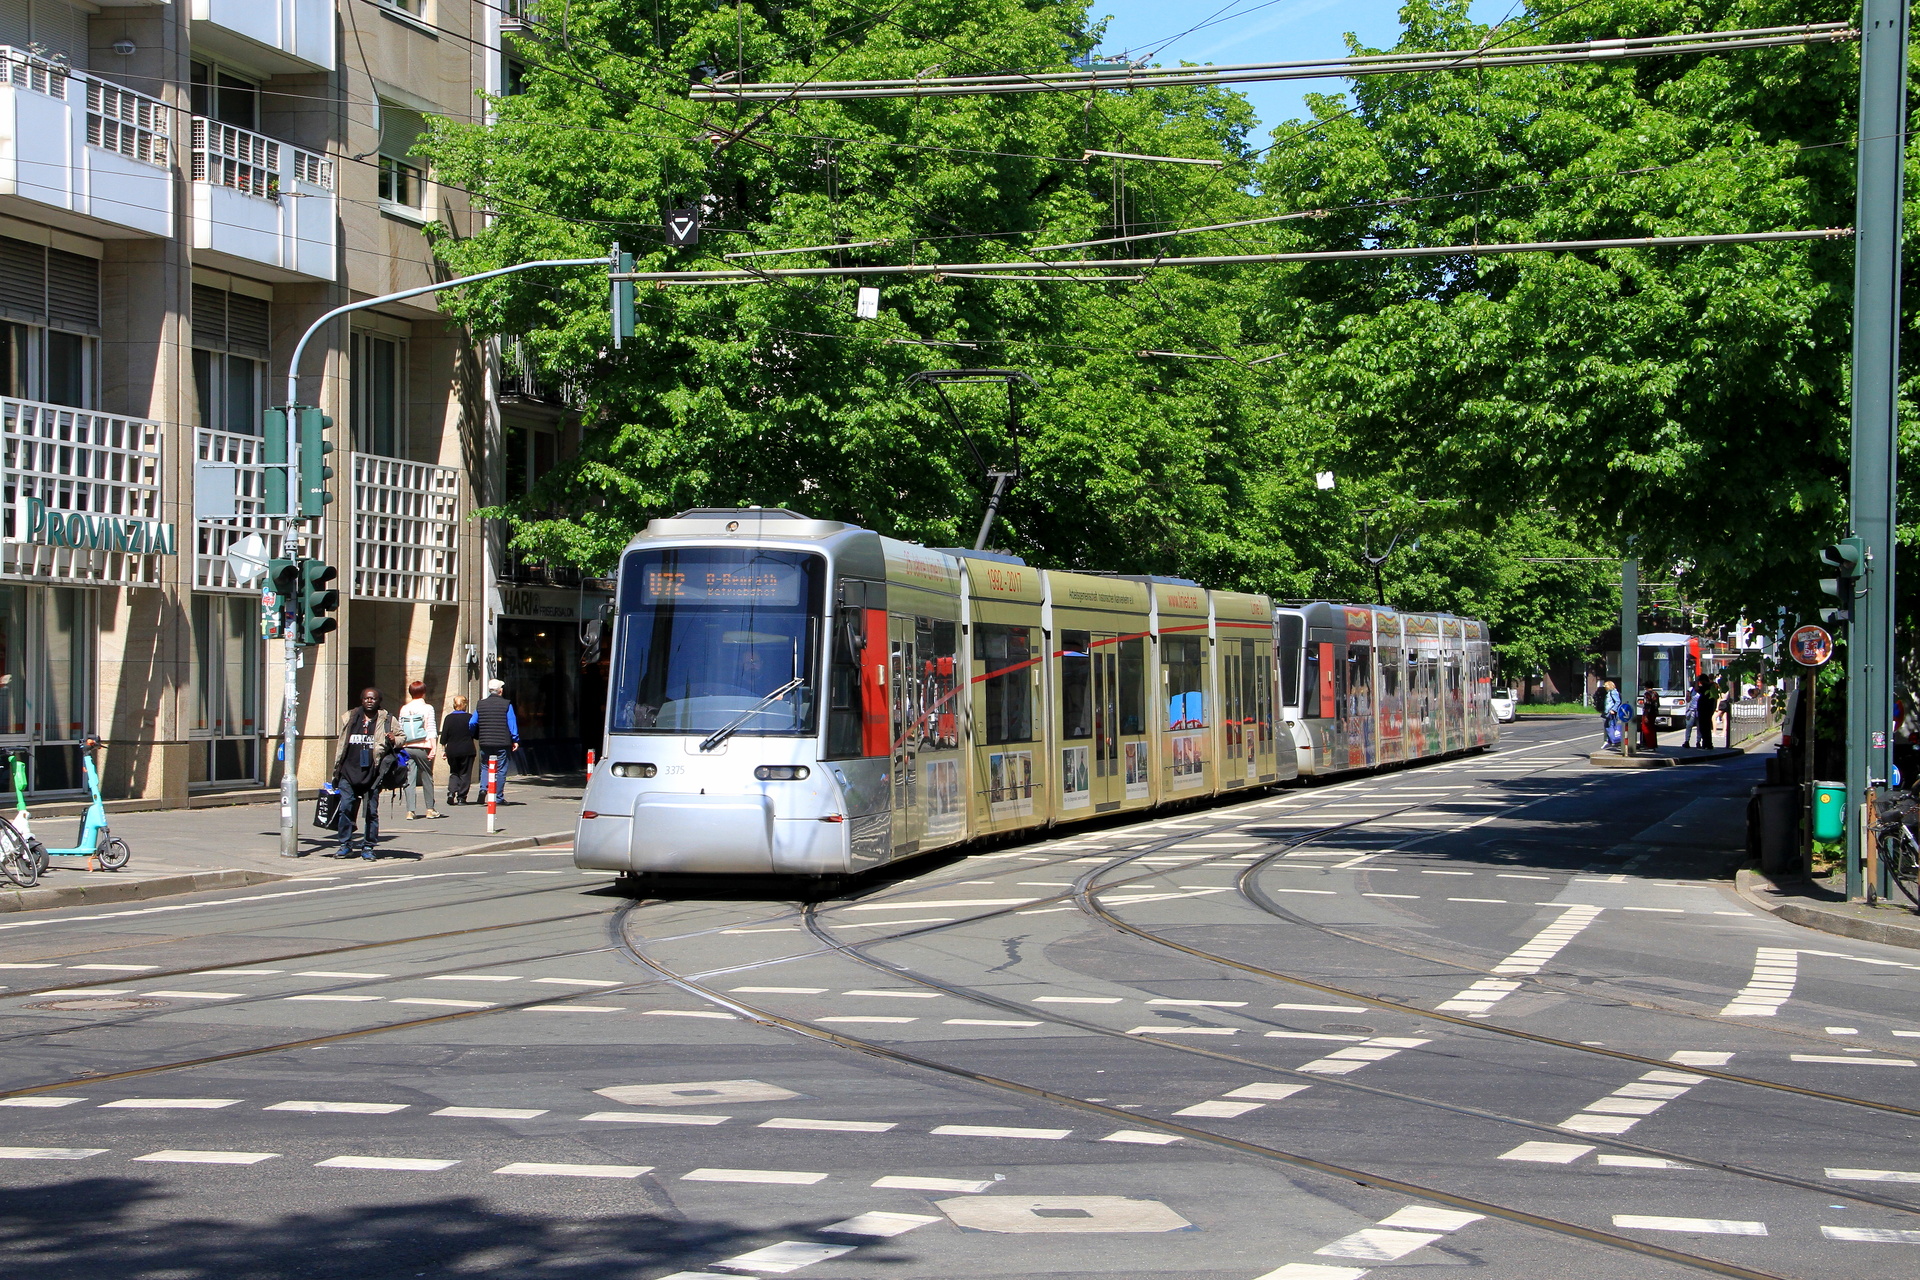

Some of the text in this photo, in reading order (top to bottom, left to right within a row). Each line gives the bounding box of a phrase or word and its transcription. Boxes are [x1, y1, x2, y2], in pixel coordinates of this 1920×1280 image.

[27, 496, 177, 556] PROVINZIAL
[650, 573, 685, 596] U72
[987, 568, 1004, 591] 1992
[1007, 571, 1023, 593] 2017
[504, 590, 532, 616] HARI
[539, 605, 574, 618] FRISEURSALON
[664, 765, 685, 775] 3375
